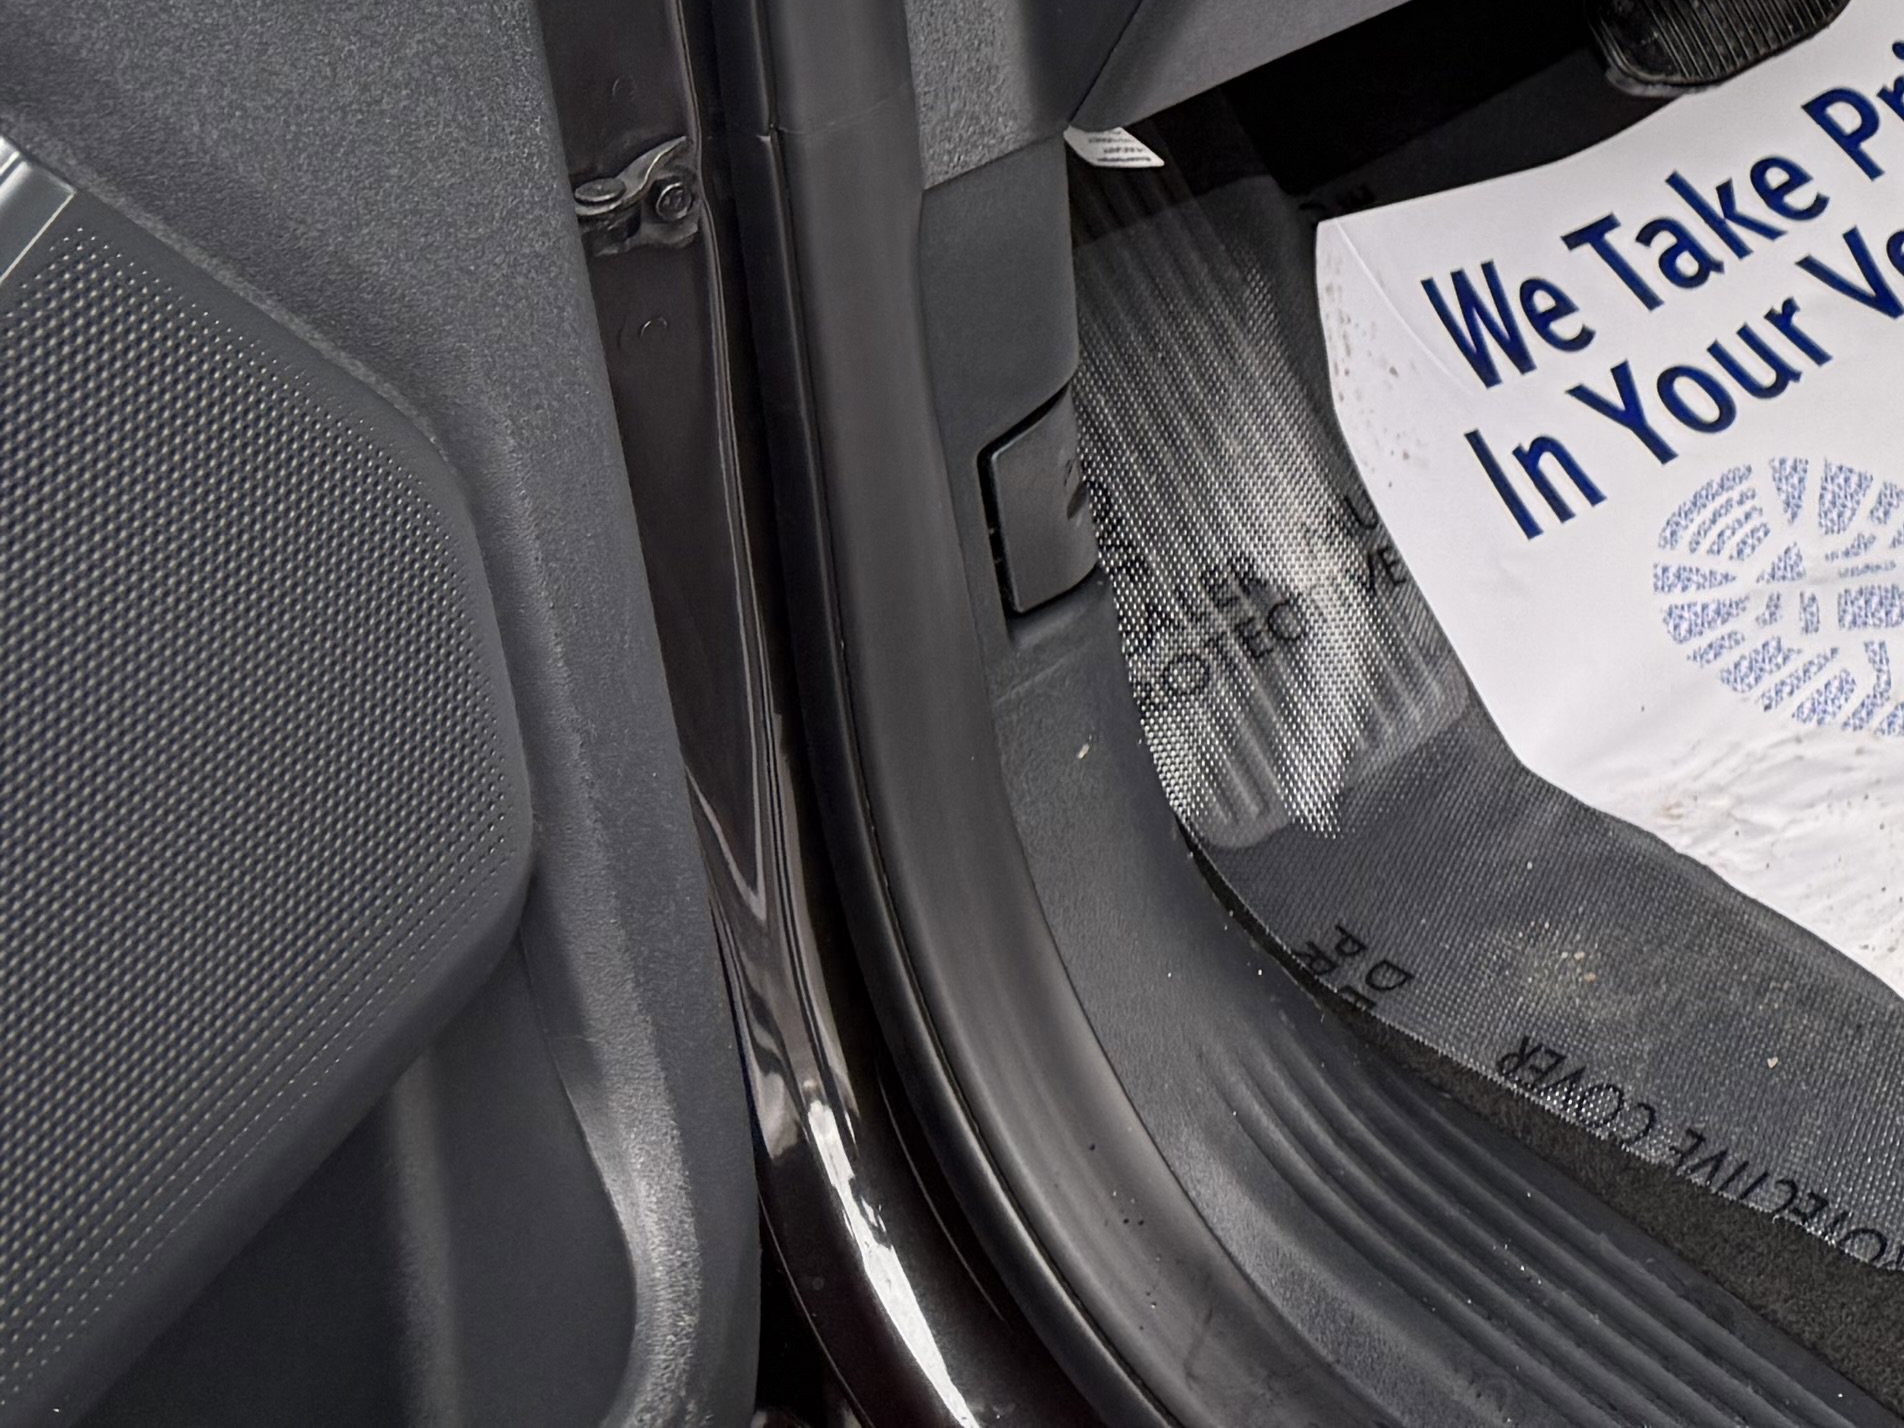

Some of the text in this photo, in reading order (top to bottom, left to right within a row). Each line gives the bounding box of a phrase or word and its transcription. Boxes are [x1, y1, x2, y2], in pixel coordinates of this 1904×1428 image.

[1420, 260, 1597, 389] We
[1560, 153, 1831, 312] Take
[1464, 427, 1608, 540] In
[1565, 294, 1834, 466] Your
[1500, 1035, 1657, 1145] COVER
